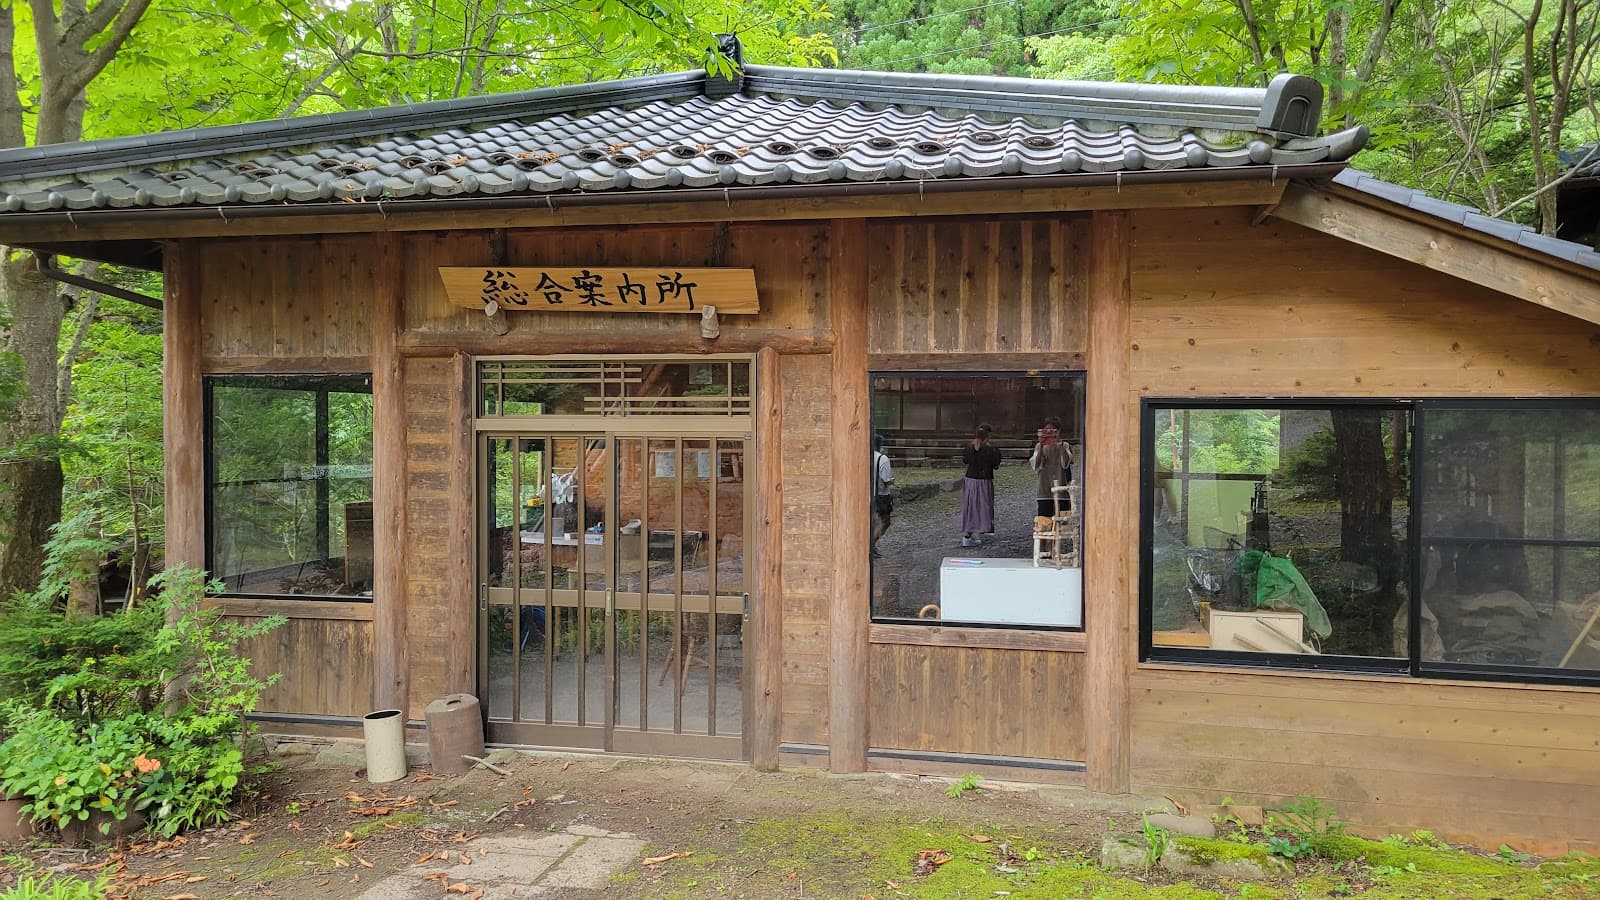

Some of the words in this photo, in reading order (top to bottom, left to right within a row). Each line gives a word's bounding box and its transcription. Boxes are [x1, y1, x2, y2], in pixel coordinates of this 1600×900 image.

[481, 270, 697, 310] 総合案内所
